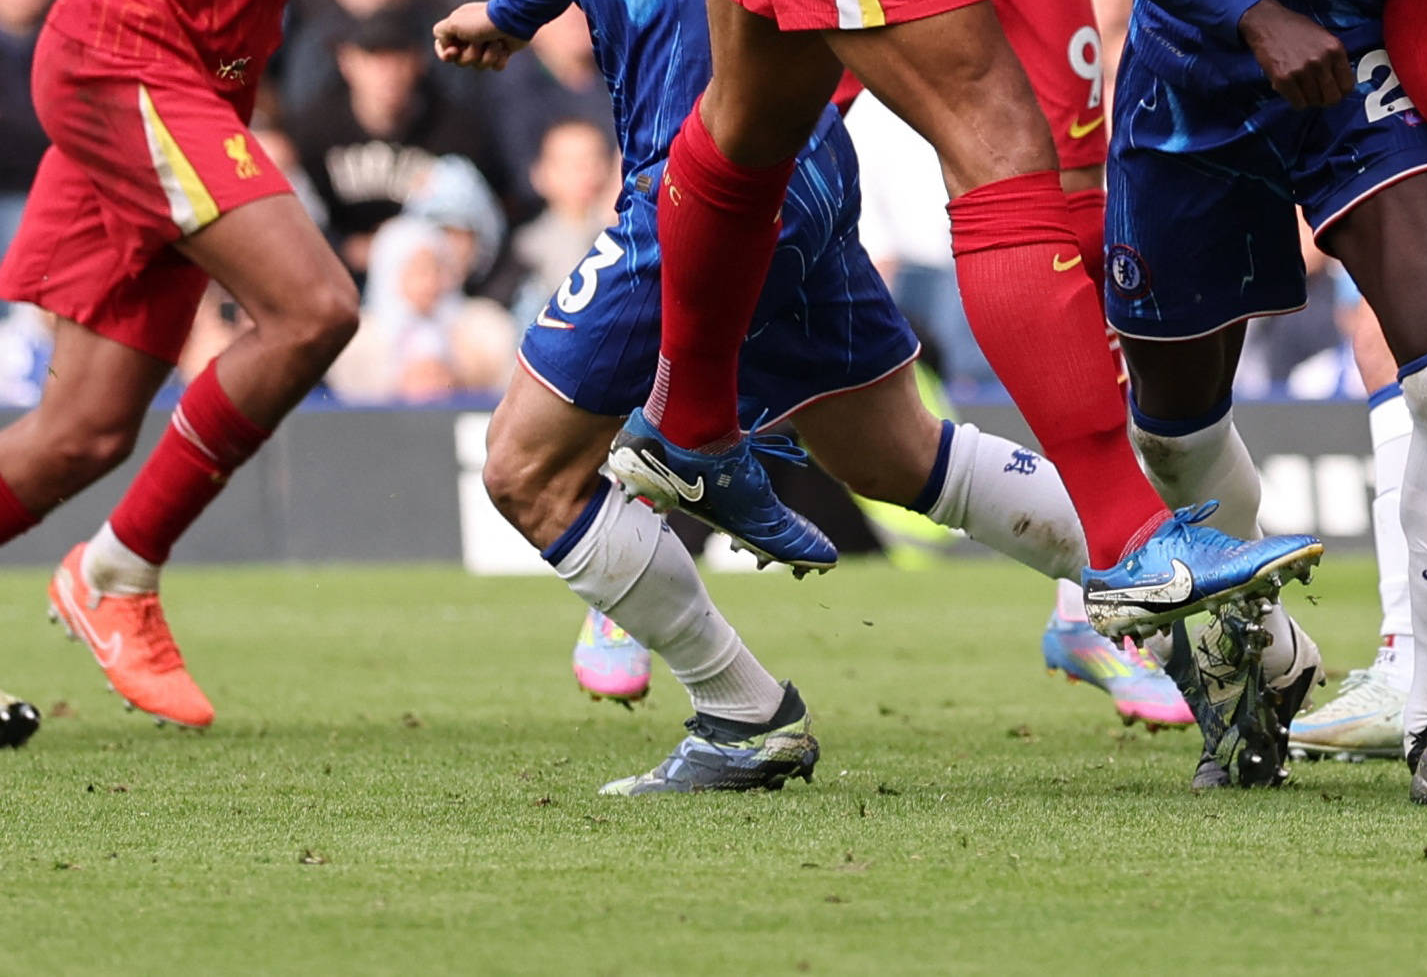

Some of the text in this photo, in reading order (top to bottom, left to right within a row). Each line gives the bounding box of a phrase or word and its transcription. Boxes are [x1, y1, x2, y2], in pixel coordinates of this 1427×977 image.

[1068, 25, 1103, 110] 9
[1357, 49, 1416, 123] 2
[557, 230, 625, 314] 3
